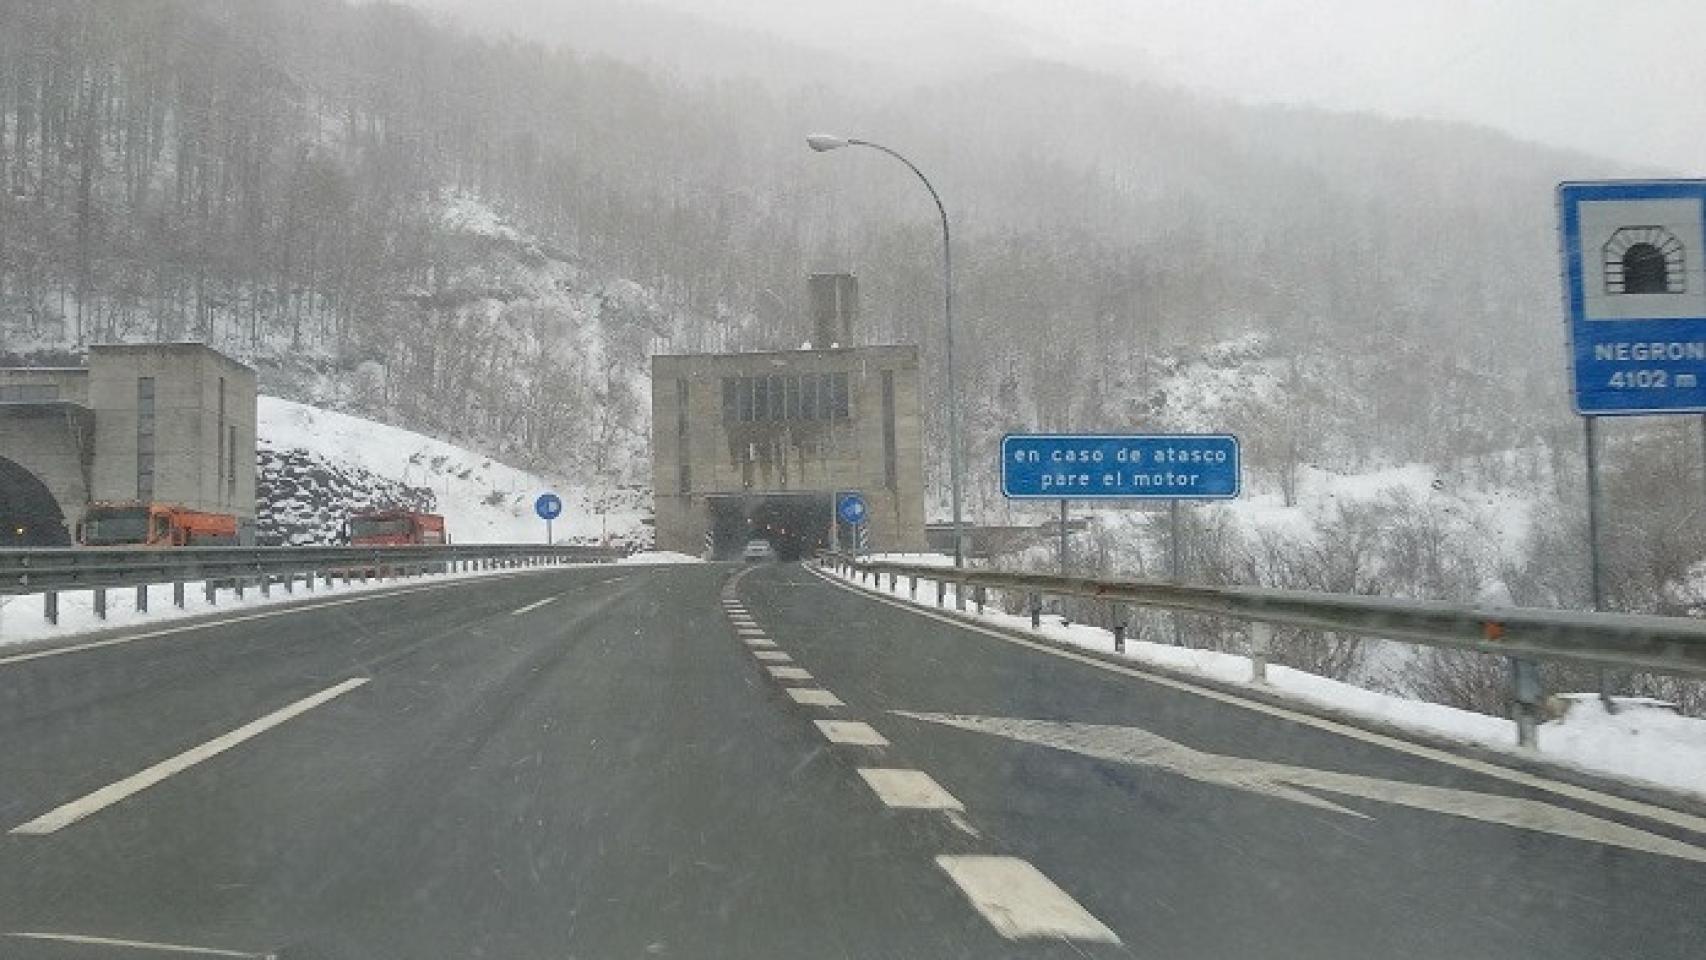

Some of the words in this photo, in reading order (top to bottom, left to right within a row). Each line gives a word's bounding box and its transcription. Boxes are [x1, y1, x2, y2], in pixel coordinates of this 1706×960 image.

[1594, 342, 1705, 361] NEGRON
[1608, 370, 1668, 388] 4102
[1014, 448, 1040, 463] en
[1051, 448, 1104, 463] caso
[1117, 446, 1142, 463] de
[1154, 447, 1227, 463] atasco
[1041, 472, 1090, 490] pare
[1102, 471, 1121, 486] el
[1134, 472, 1200, 486] motor
